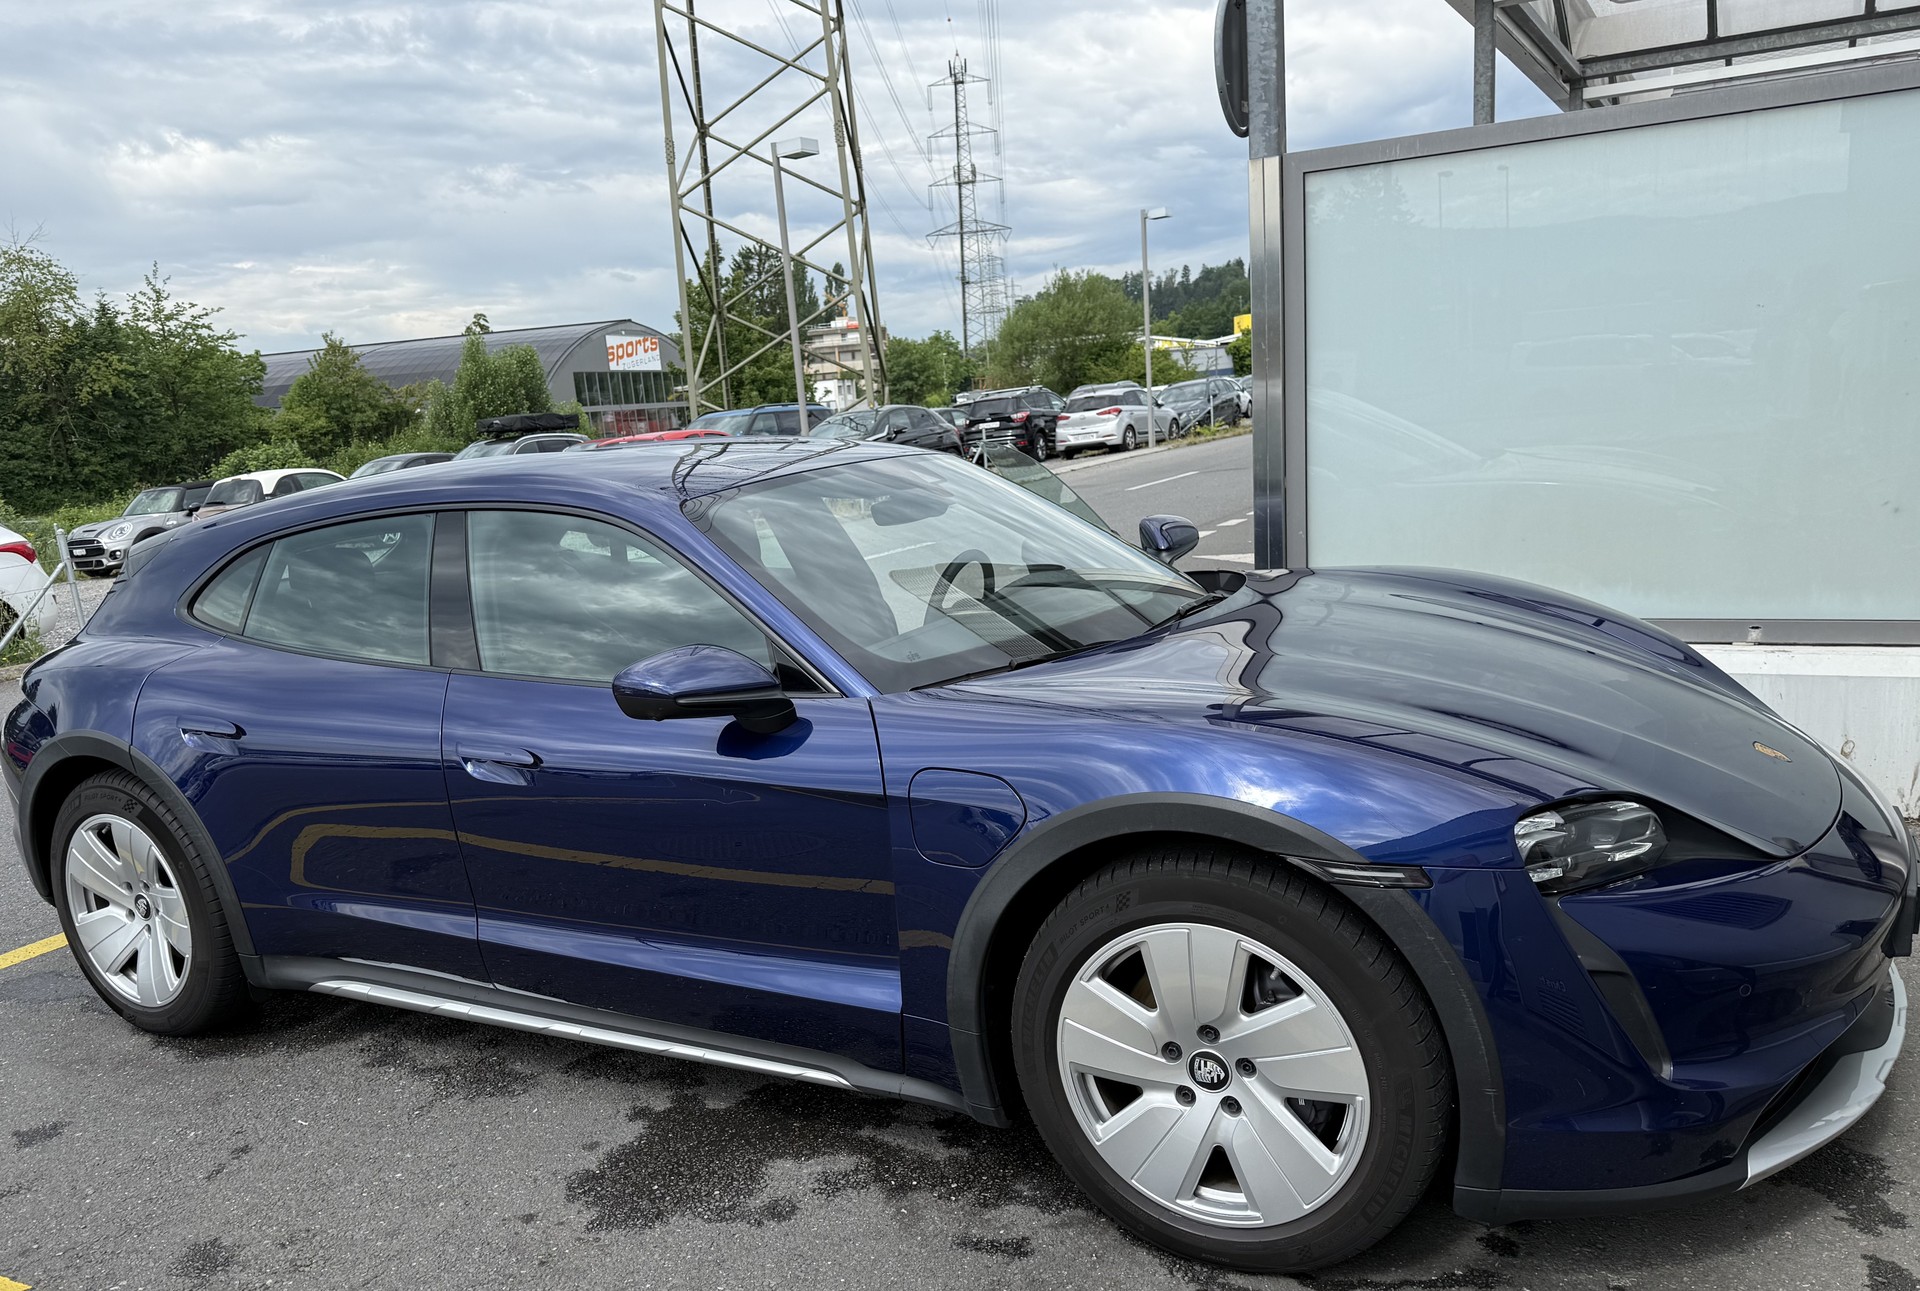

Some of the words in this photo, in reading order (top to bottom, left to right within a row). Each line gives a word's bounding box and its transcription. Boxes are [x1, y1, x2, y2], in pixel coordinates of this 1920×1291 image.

[607, 336, 658, 366] sports
[1059, 924, 1078, 944] PILOT
[1080, 905, 1105, 926] SPORT
[1364, 1113, 1412, 1218] MICHELIN
